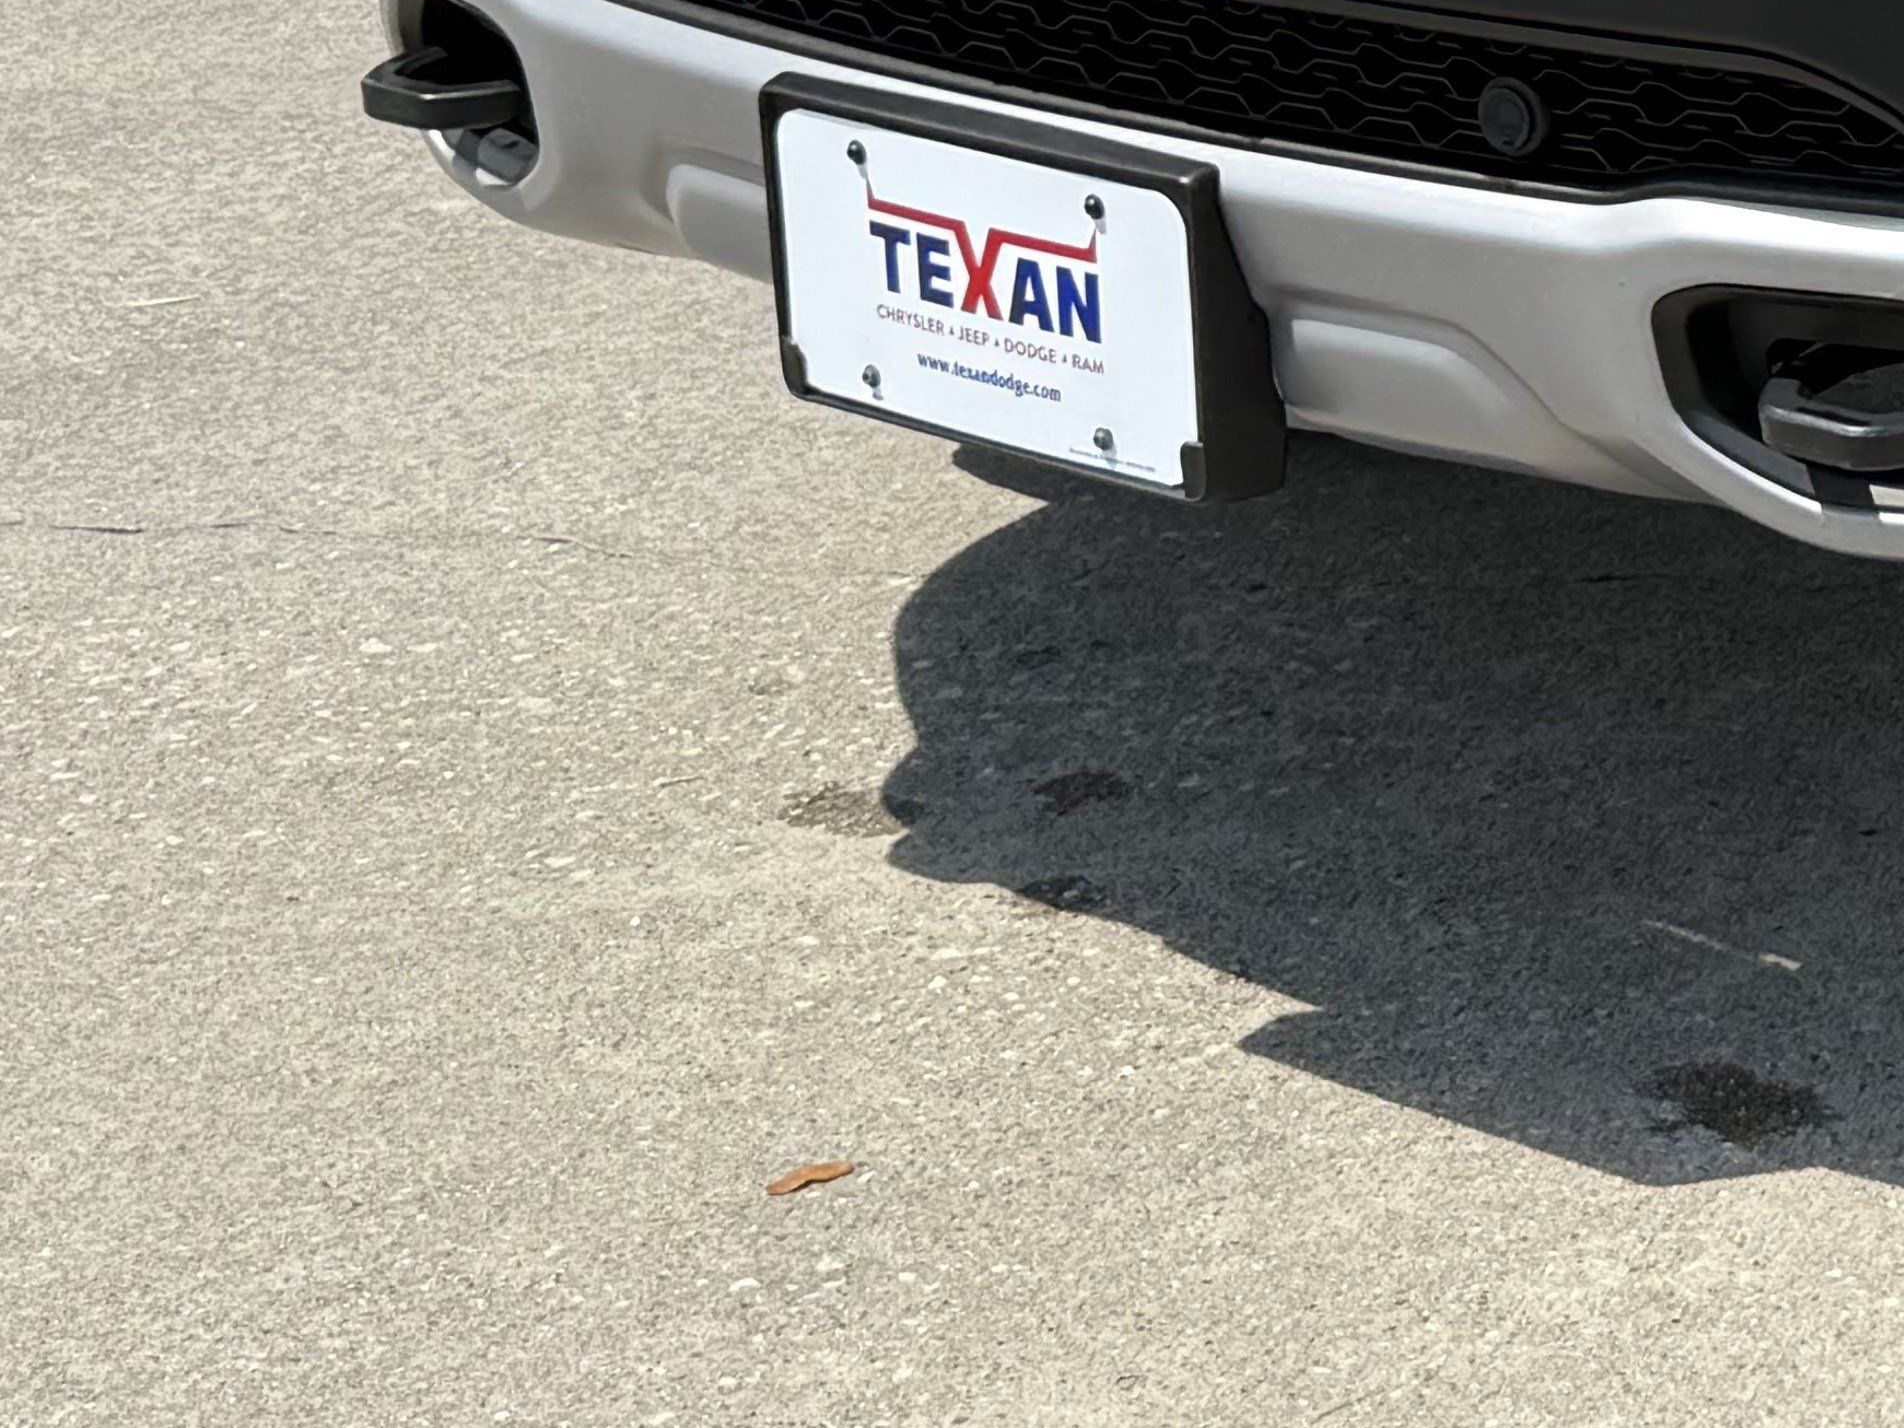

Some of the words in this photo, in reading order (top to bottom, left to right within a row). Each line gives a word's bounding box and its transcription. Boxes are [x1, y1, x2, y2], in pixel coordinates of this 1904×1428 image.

[868, 194, 1102, 344] TEXAN
[876, 304, 945, 336] CHRYSLER
[958, 326, 990, 346] JEEP
[1004, 337, 1056, 364] DODGE
[1071, 353, 1104, 376] RAM
[917, 353, 1062, 402] www.texandodge.com
